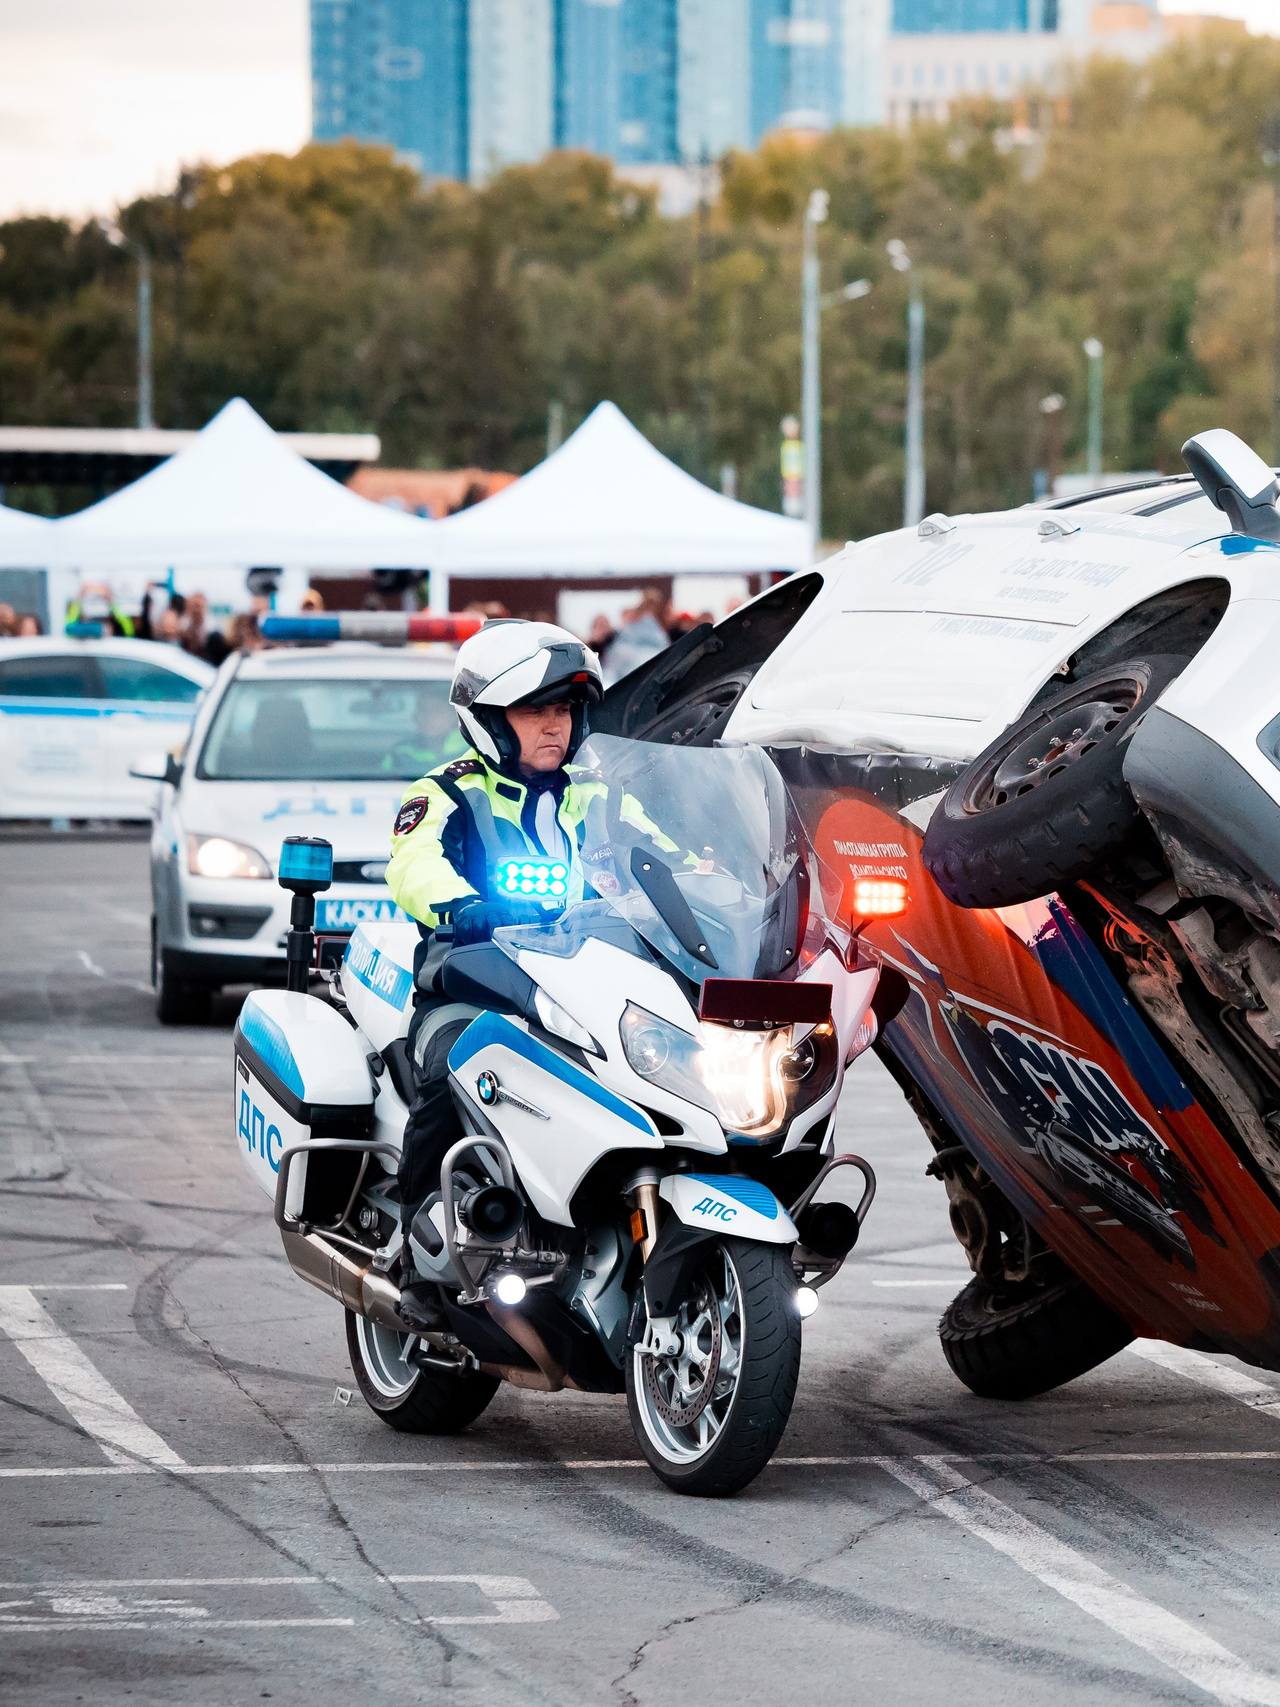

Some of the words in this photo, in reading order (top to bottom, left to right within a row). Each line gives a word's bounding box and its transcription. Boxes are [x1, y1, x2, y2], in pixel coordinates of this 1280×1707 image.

[1027, 558, 1079, 581] ДПС
[262, 797, 402, 820] ДП
[876, 843, 909, 858] ГРУППА
[238, 1088, 283, 1173] ДПС
[692, 1196, 738, 1222] ДПС
